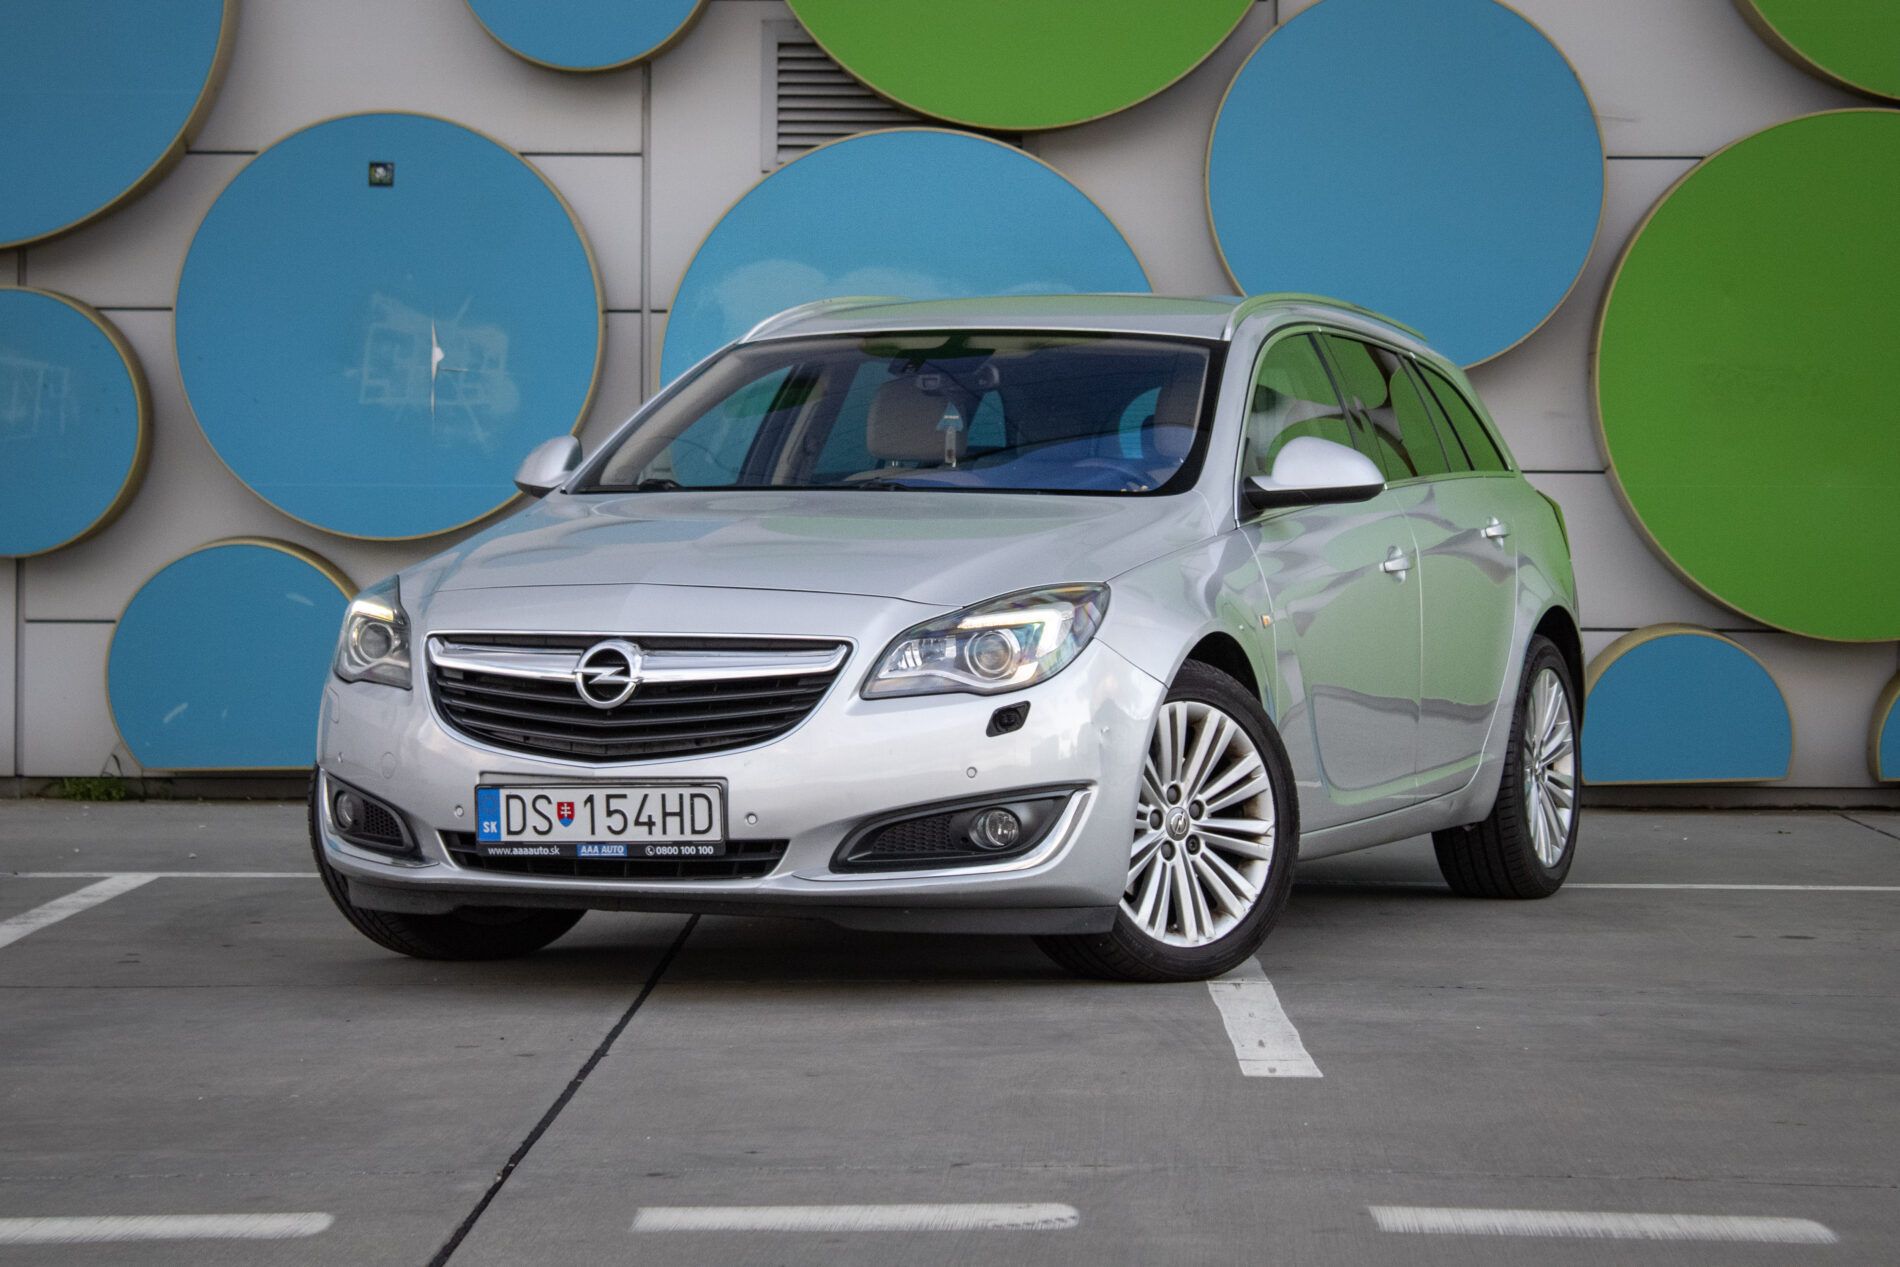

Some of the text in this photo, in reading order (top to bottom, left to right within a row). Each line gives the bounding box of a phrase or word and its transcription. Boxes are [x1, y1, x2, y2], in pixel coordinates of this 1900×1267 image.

[506, 793, 713, 836] DS 154HD
[483, 821, 497, 833] SK
[488, 846, 560, 855] www.aaaauto.sk
[581, 845, 624, 854] AAA AUTO
[656, 846, 714, 855] 0800 100 100
